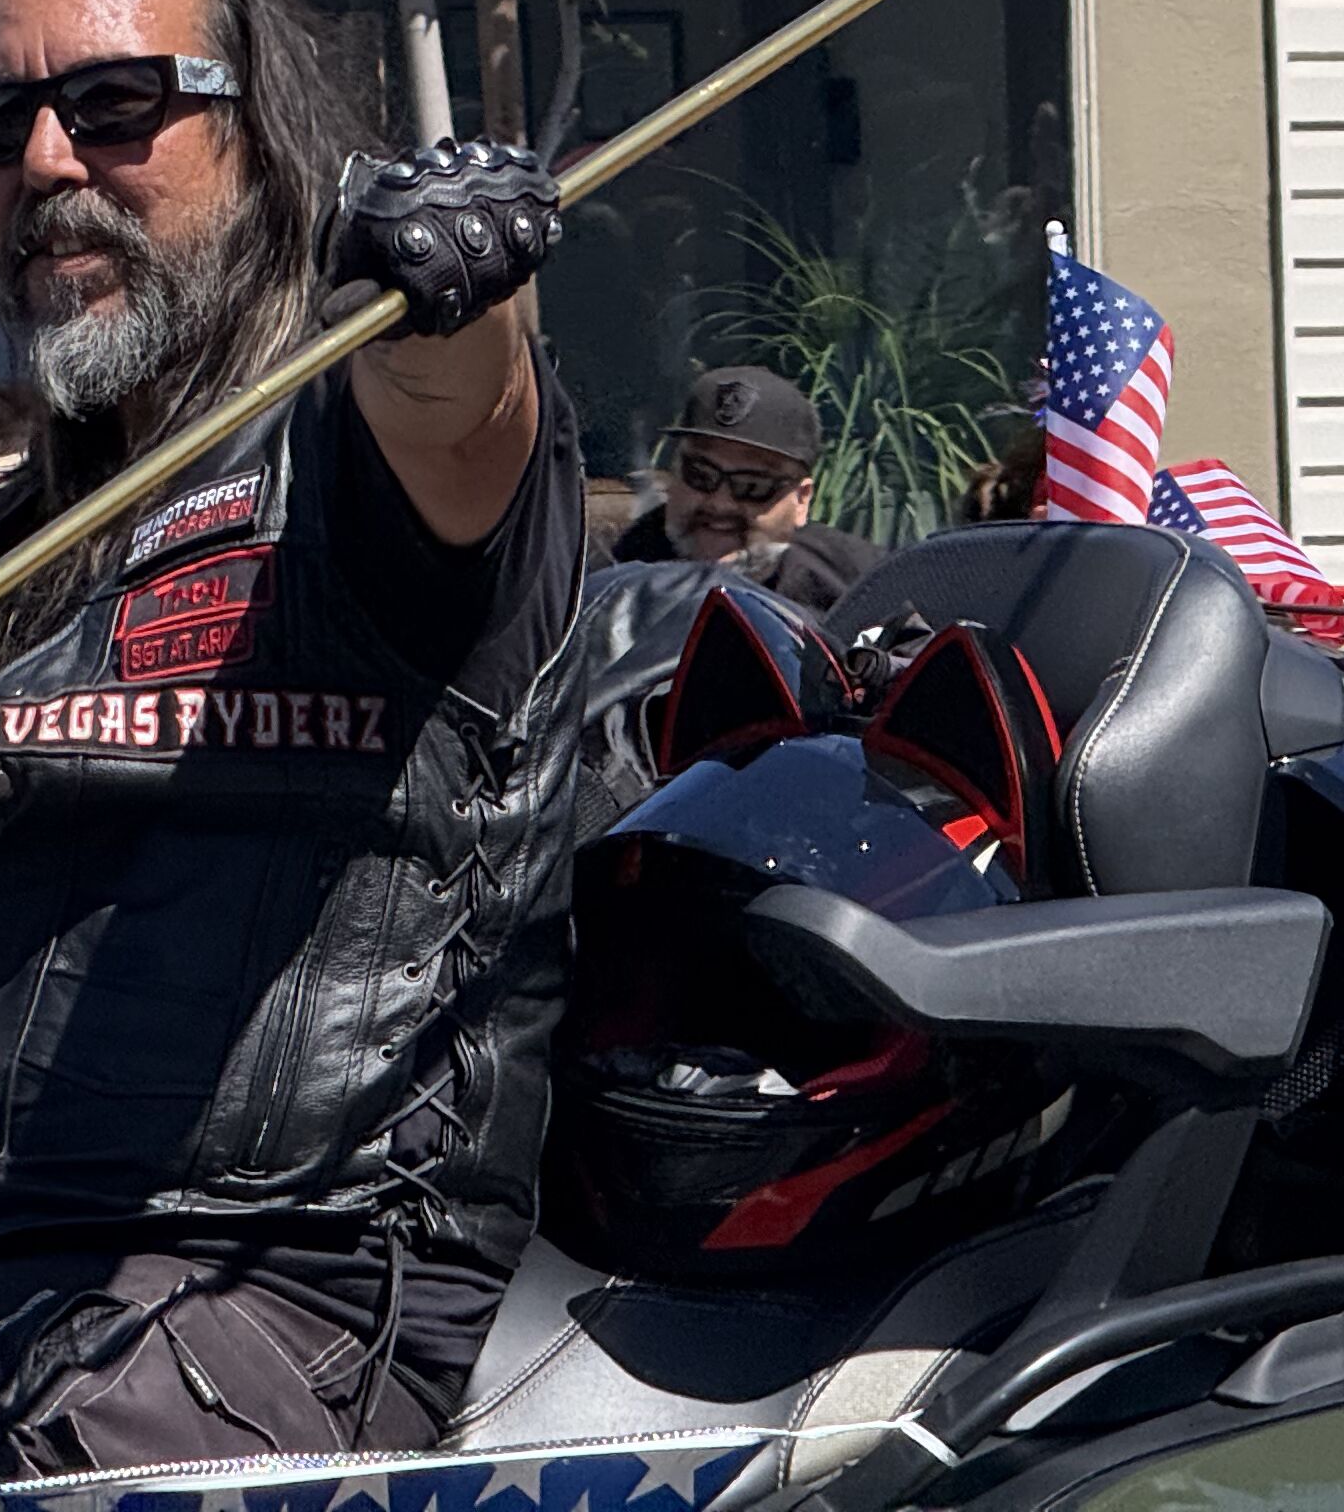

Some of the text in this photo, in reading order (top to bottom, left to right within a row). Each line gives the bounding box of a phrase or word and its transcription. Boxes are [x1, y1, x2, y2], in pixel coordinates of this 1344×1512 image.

[125, 498, 254, 566] JUST FORGIVEN
[154, 498, 188, 530] NOT
[184, 474, 262, 516] PERFECT
[130, 621, 248, 670] SGT AT ARM
[1, 688, 388, 752] VEGAS RYDERZ
